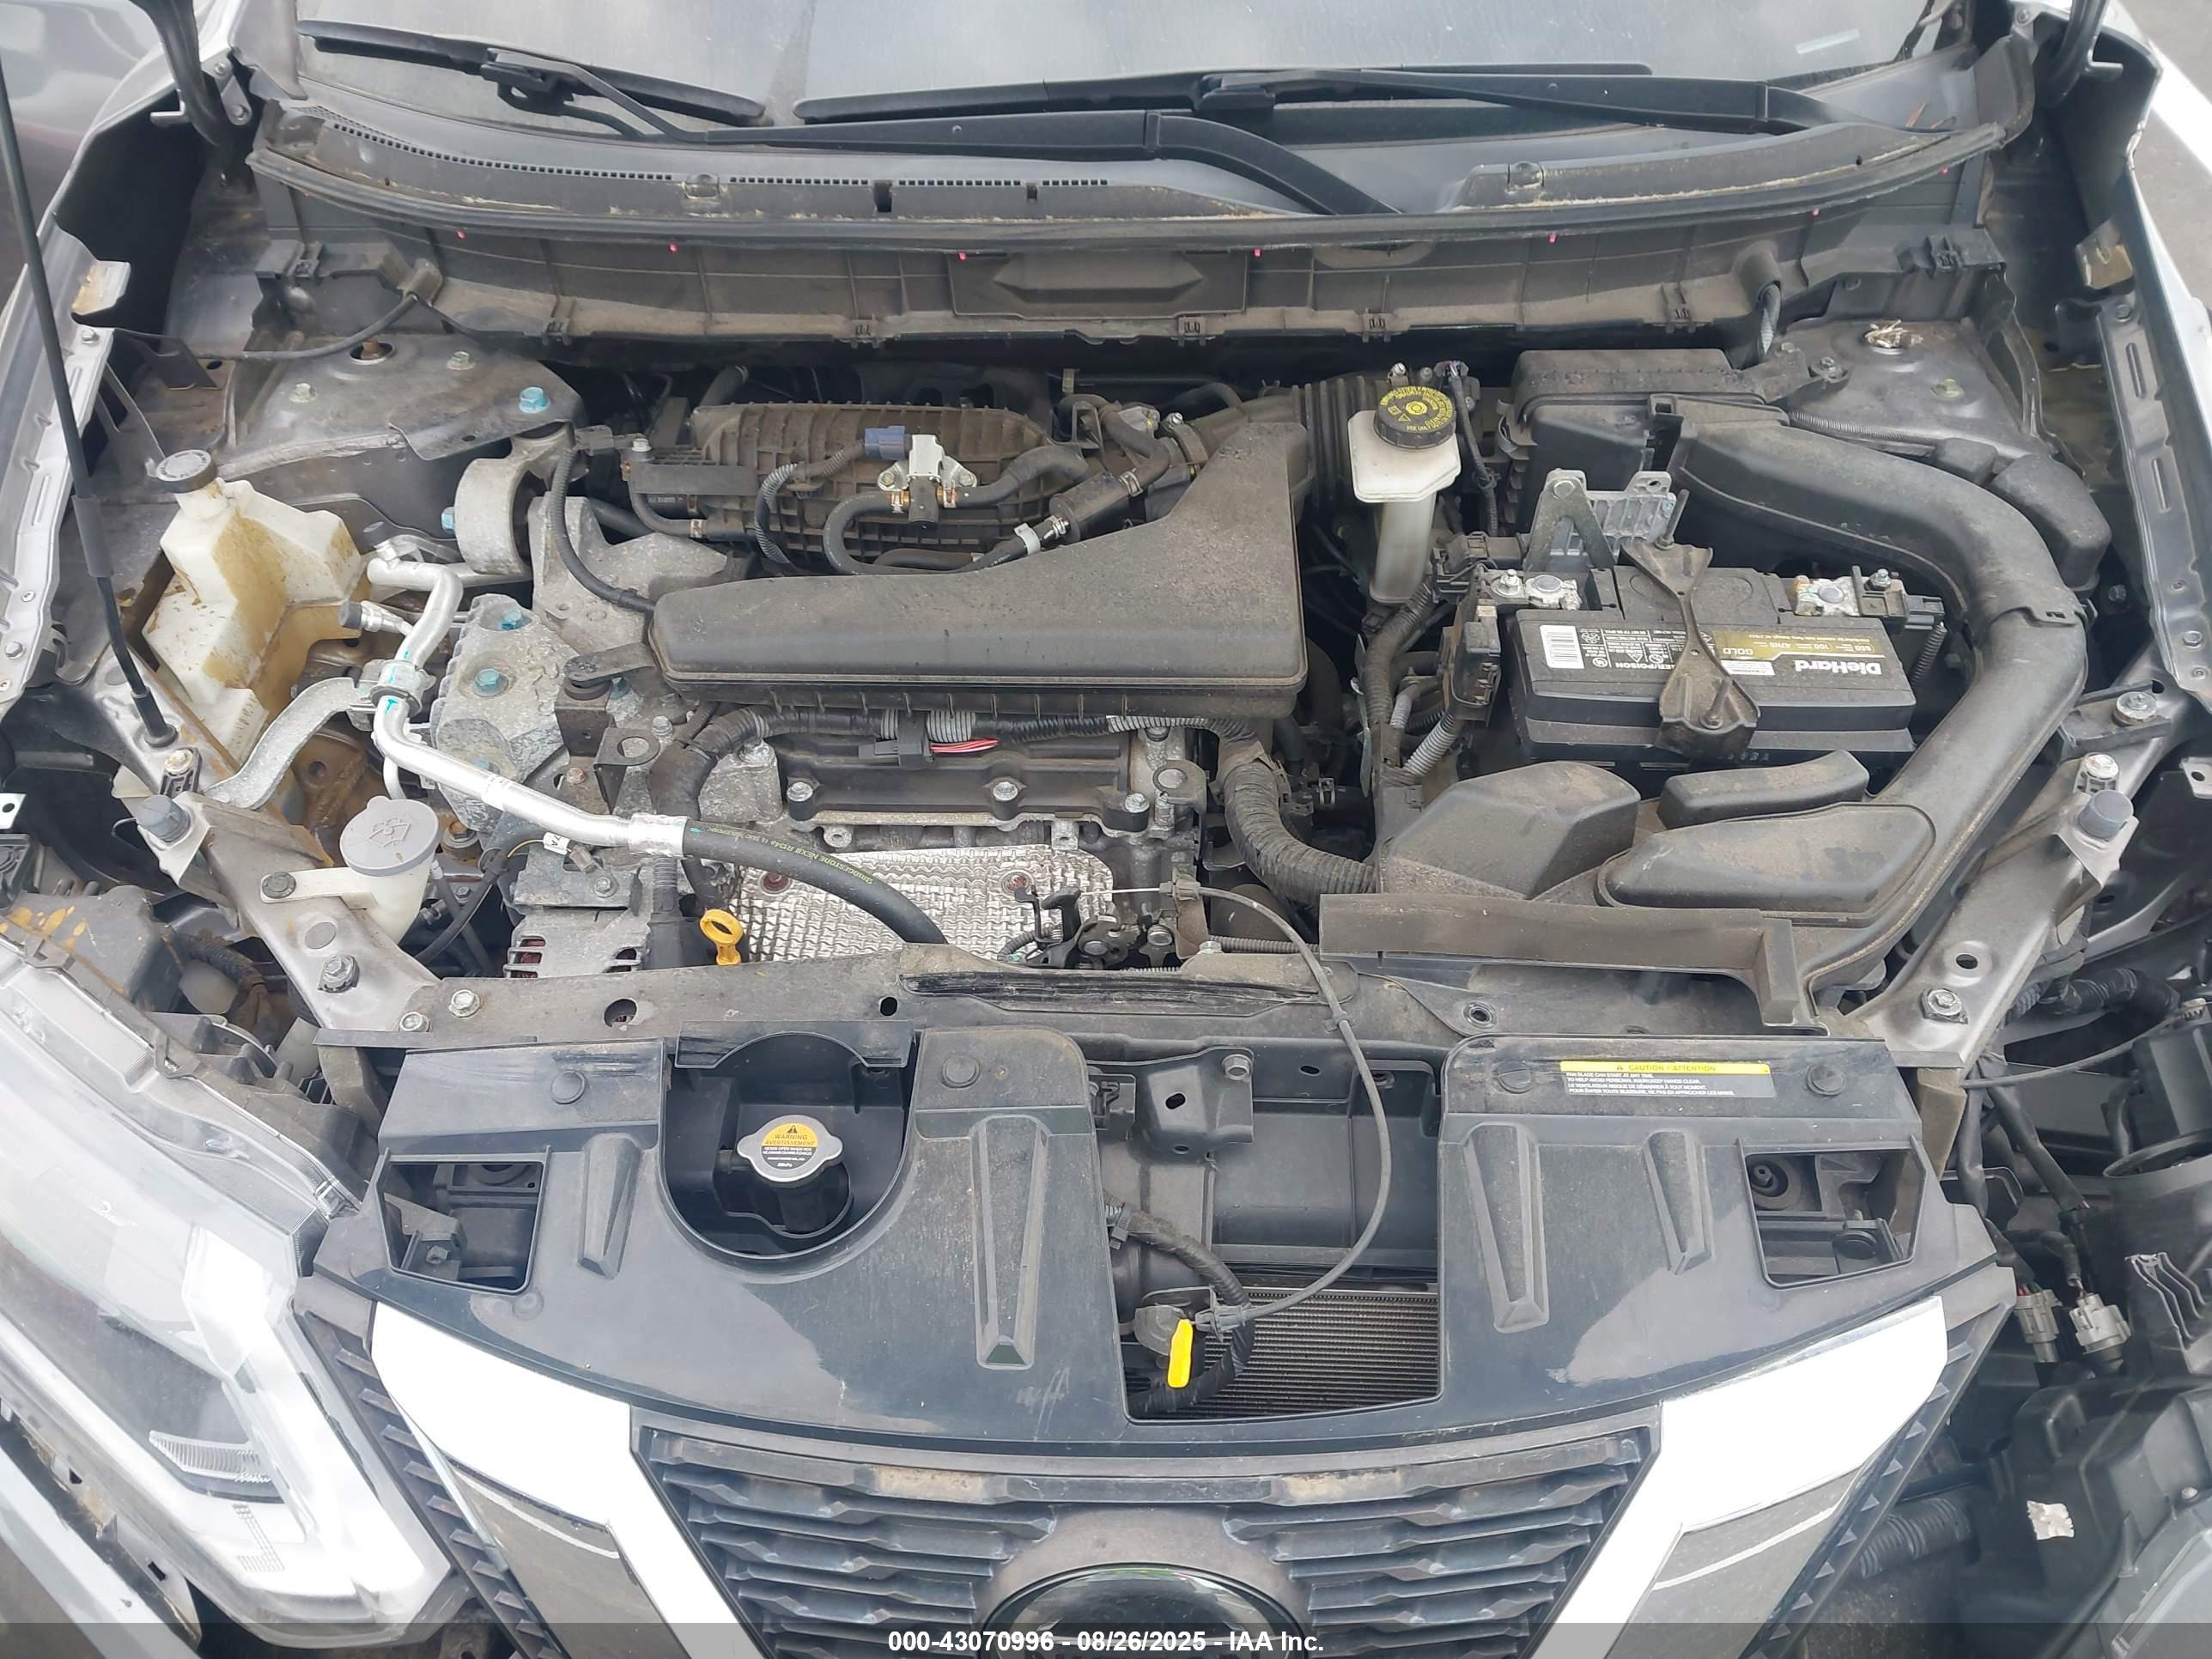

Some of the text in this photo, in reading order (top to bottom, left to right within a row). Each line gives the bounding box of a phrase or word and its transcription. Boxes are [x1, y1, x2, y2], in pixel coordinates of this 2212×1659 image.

[1723, 647, 1754, 656] GOLD
[1795, 659, 1882, 675] DieHard
[818, 855, 873, 884] BRIDGESTONE
